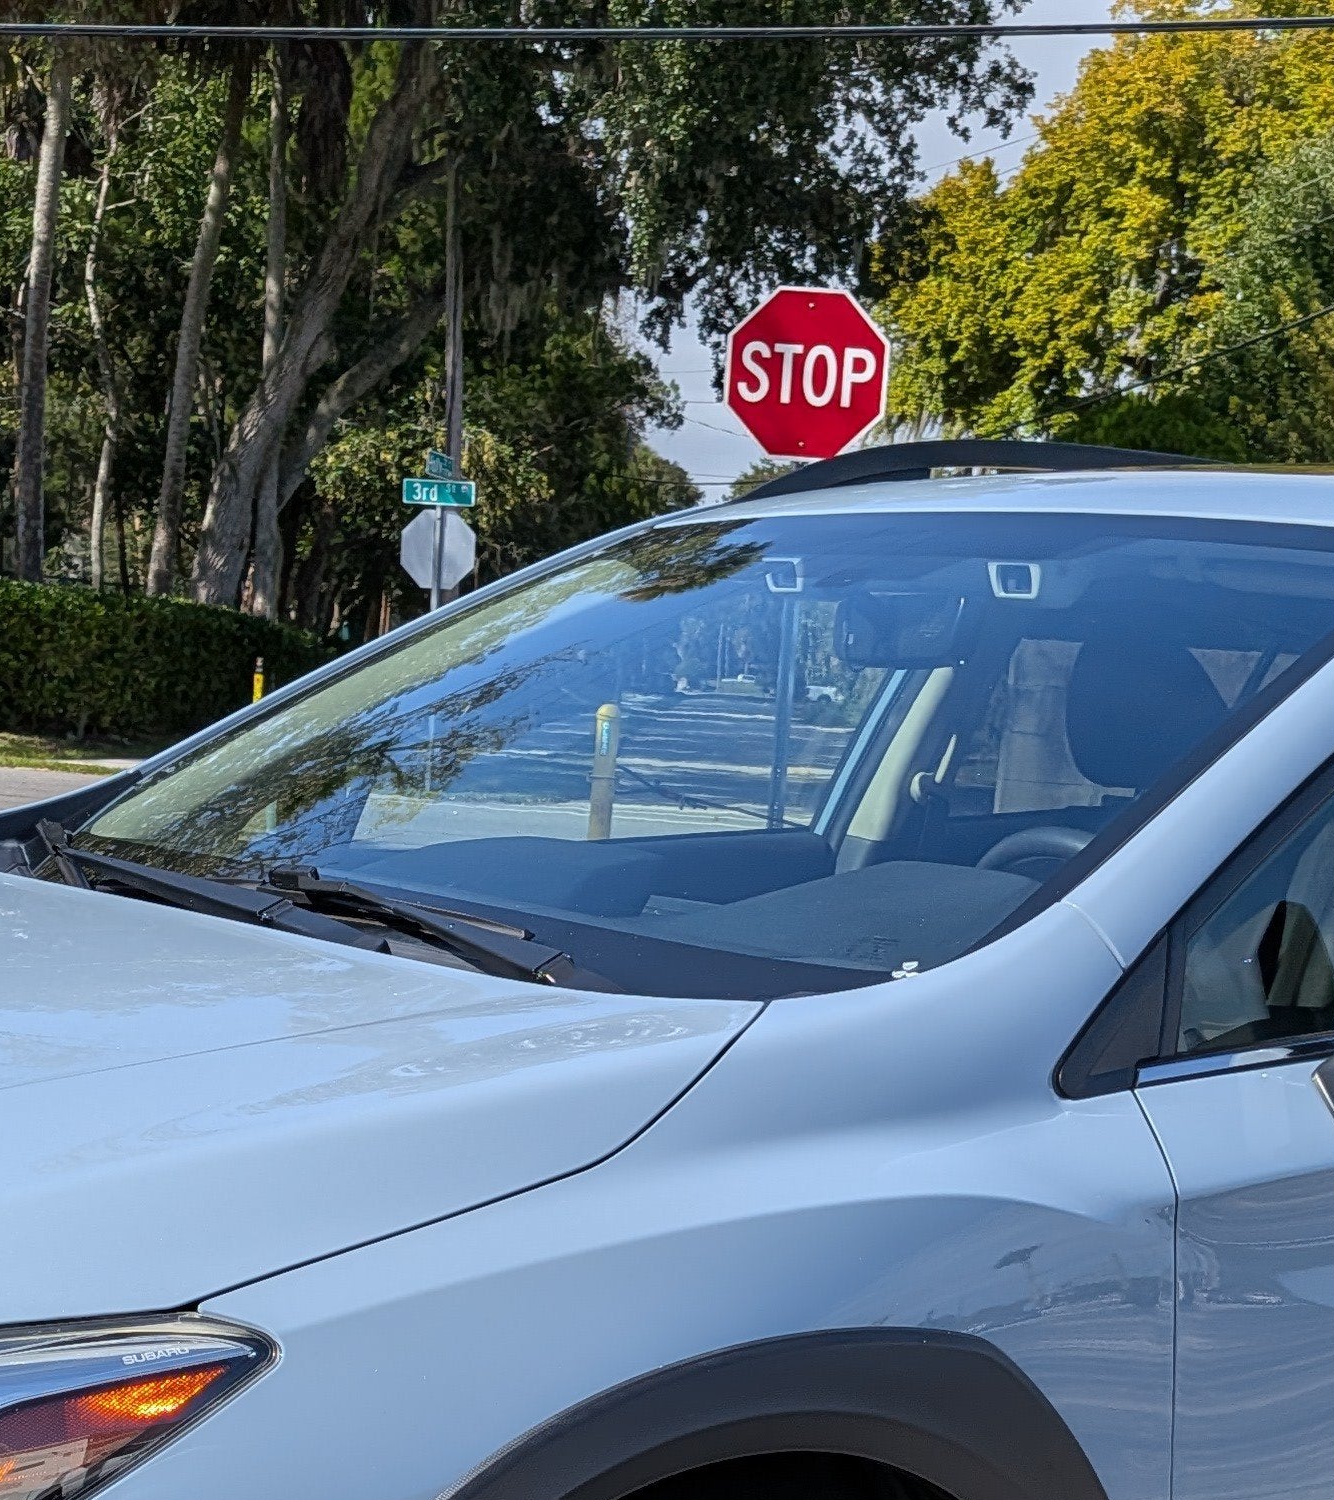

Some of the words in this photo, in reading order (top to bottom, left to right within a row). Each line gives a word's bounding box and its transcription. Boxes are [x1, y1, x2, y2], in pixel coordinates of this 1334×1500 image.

[737, 340, 877, 408] STOP
[412, 482, 438, 502] 3rd
[122, 1347, 190, 1365] SUBARU
